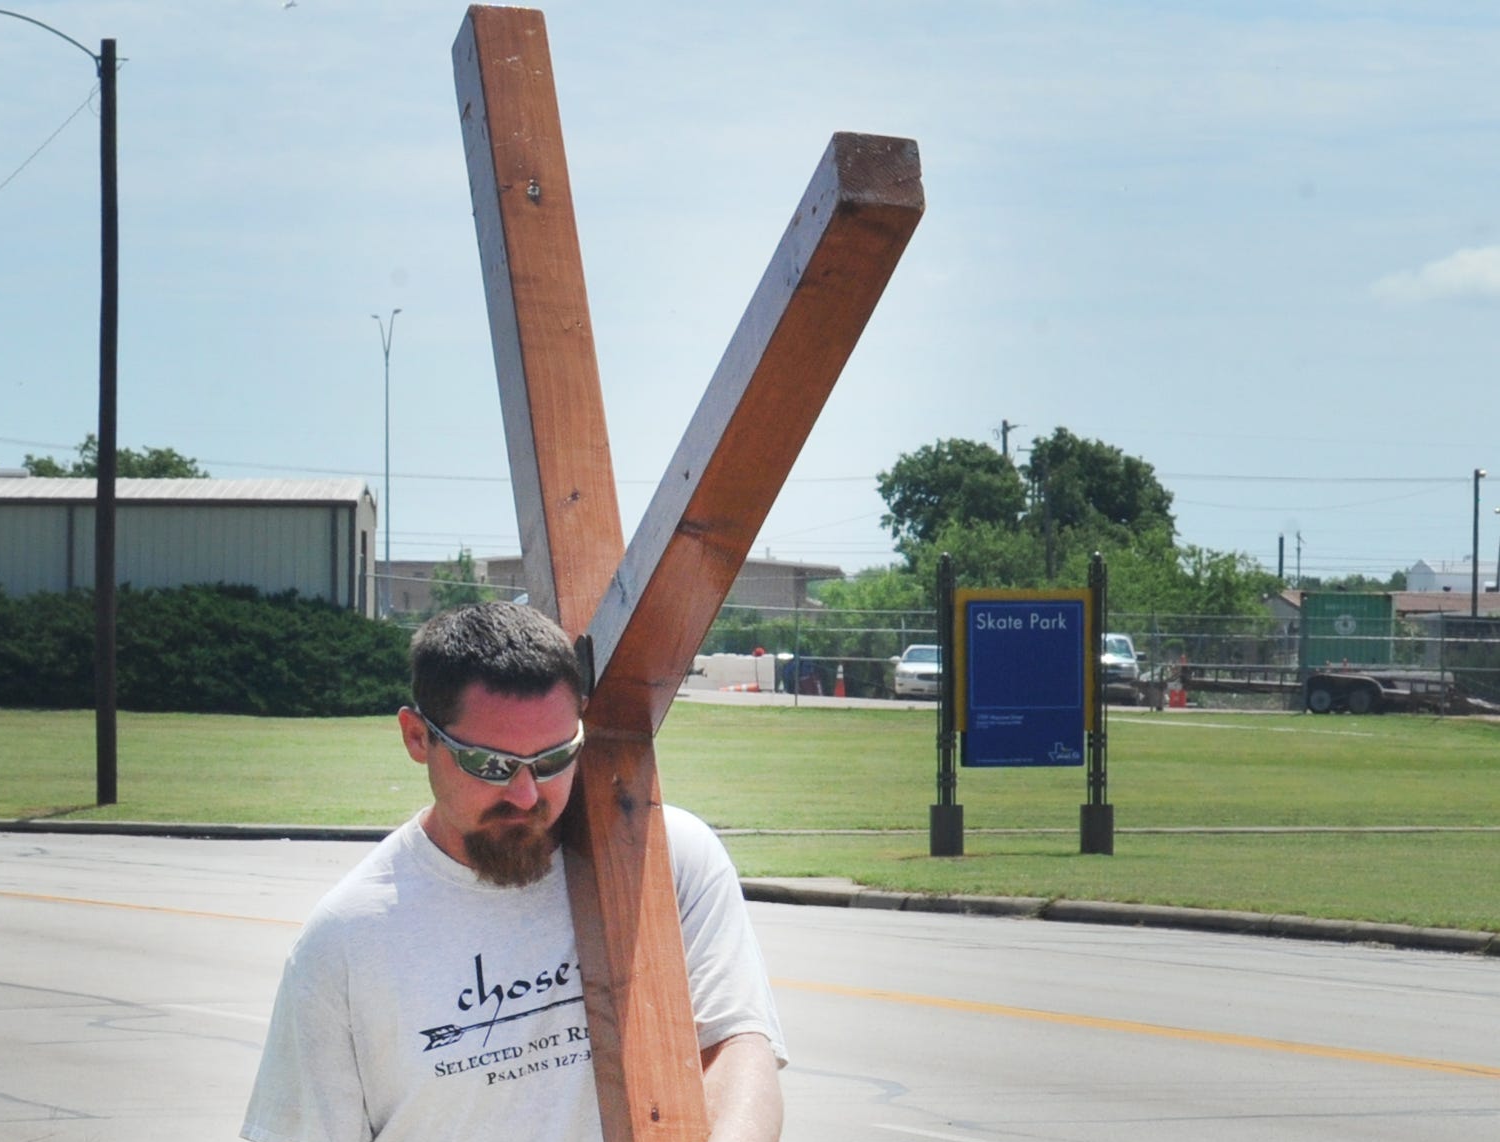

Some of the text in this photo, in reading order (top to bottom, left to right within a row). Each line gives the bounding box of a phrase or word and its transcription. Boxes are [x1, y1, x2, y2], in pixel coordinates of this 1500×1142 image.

[976, 612, 1067, 630] Skate Park
[457, 952, 582, 1048] chose
[434, 1046, 523, 1078] SELECTED
[486, 1059, 550, 1086] PSALMS
